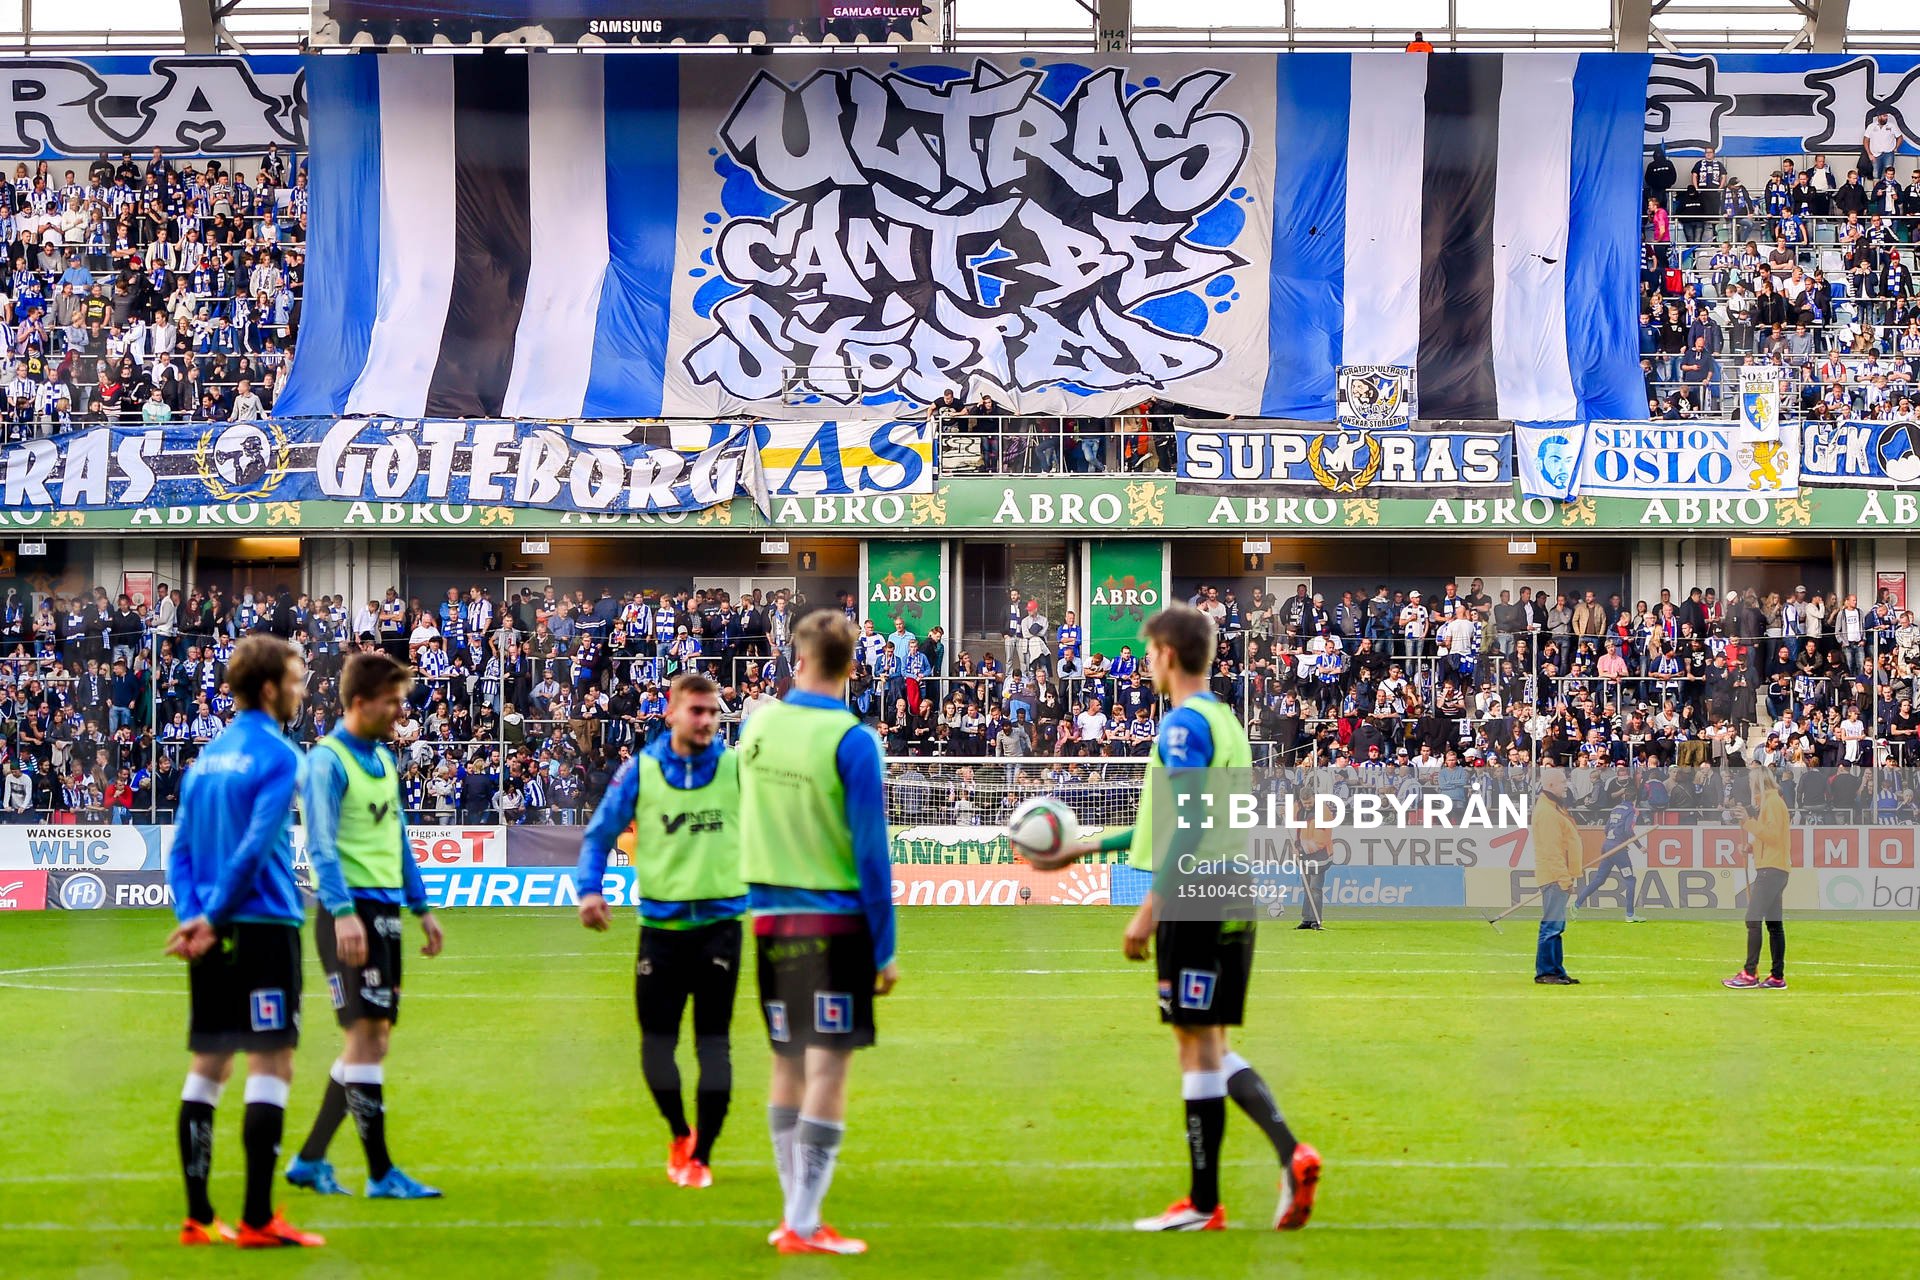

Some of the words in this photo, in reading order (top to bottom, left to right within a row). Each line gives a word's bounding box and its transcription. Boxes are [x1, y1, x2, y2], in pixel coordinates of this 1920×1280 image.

[833, 6, 873, 17] GAMLA
[883, 6, 920, 17] ULLEVI
[589, 20, 662, 33] SAMSUNG
[717, 57, 1254, 215] ULTRAS
[1010, 196, 1252, 306] BE
[1594, 429, 1730, 452] SEKTION
[316, 419, 744, 509] GÖTEBORG
[1185, 433, 1309, 480] SUP
[1381, 435, 1501, 483] RAS
[1594, 450, 1733, 485] OSLO
[992, 488, 1123, 525] ÅBRO
[870, 584, 937, 602] ÅBRO
[1091, 587, 1158, 605] ÅBRO
[26, 829, 112, 838] WANGESKOG
[407, 829, 451, 839] frigga.se
[29, 840, 110, 865] WHC
[1360, 838, 1479, 867] TYRES
[1873, 875, 1920, 909] ba
